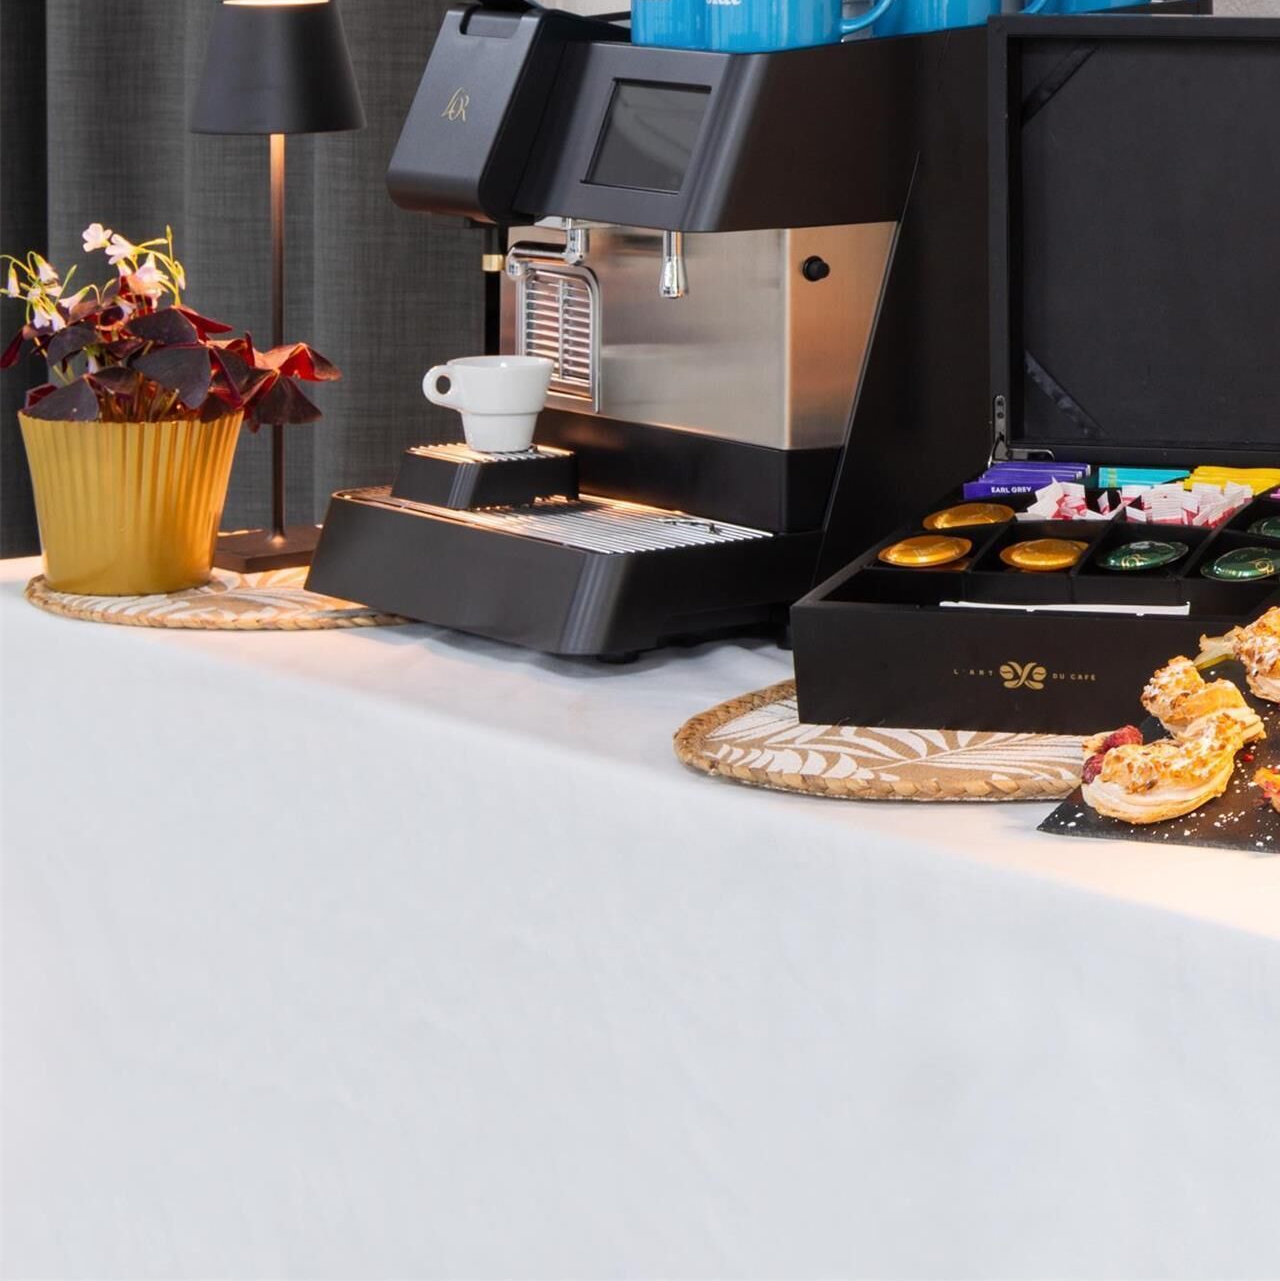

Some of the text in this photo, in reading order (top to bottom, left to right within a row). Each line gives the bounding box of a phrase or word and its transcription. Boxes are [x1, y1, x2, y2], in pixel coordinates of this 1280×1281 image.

[991, 486, 1032, 494] EARL GREY
[1052, 672, 1065, 680] DU
